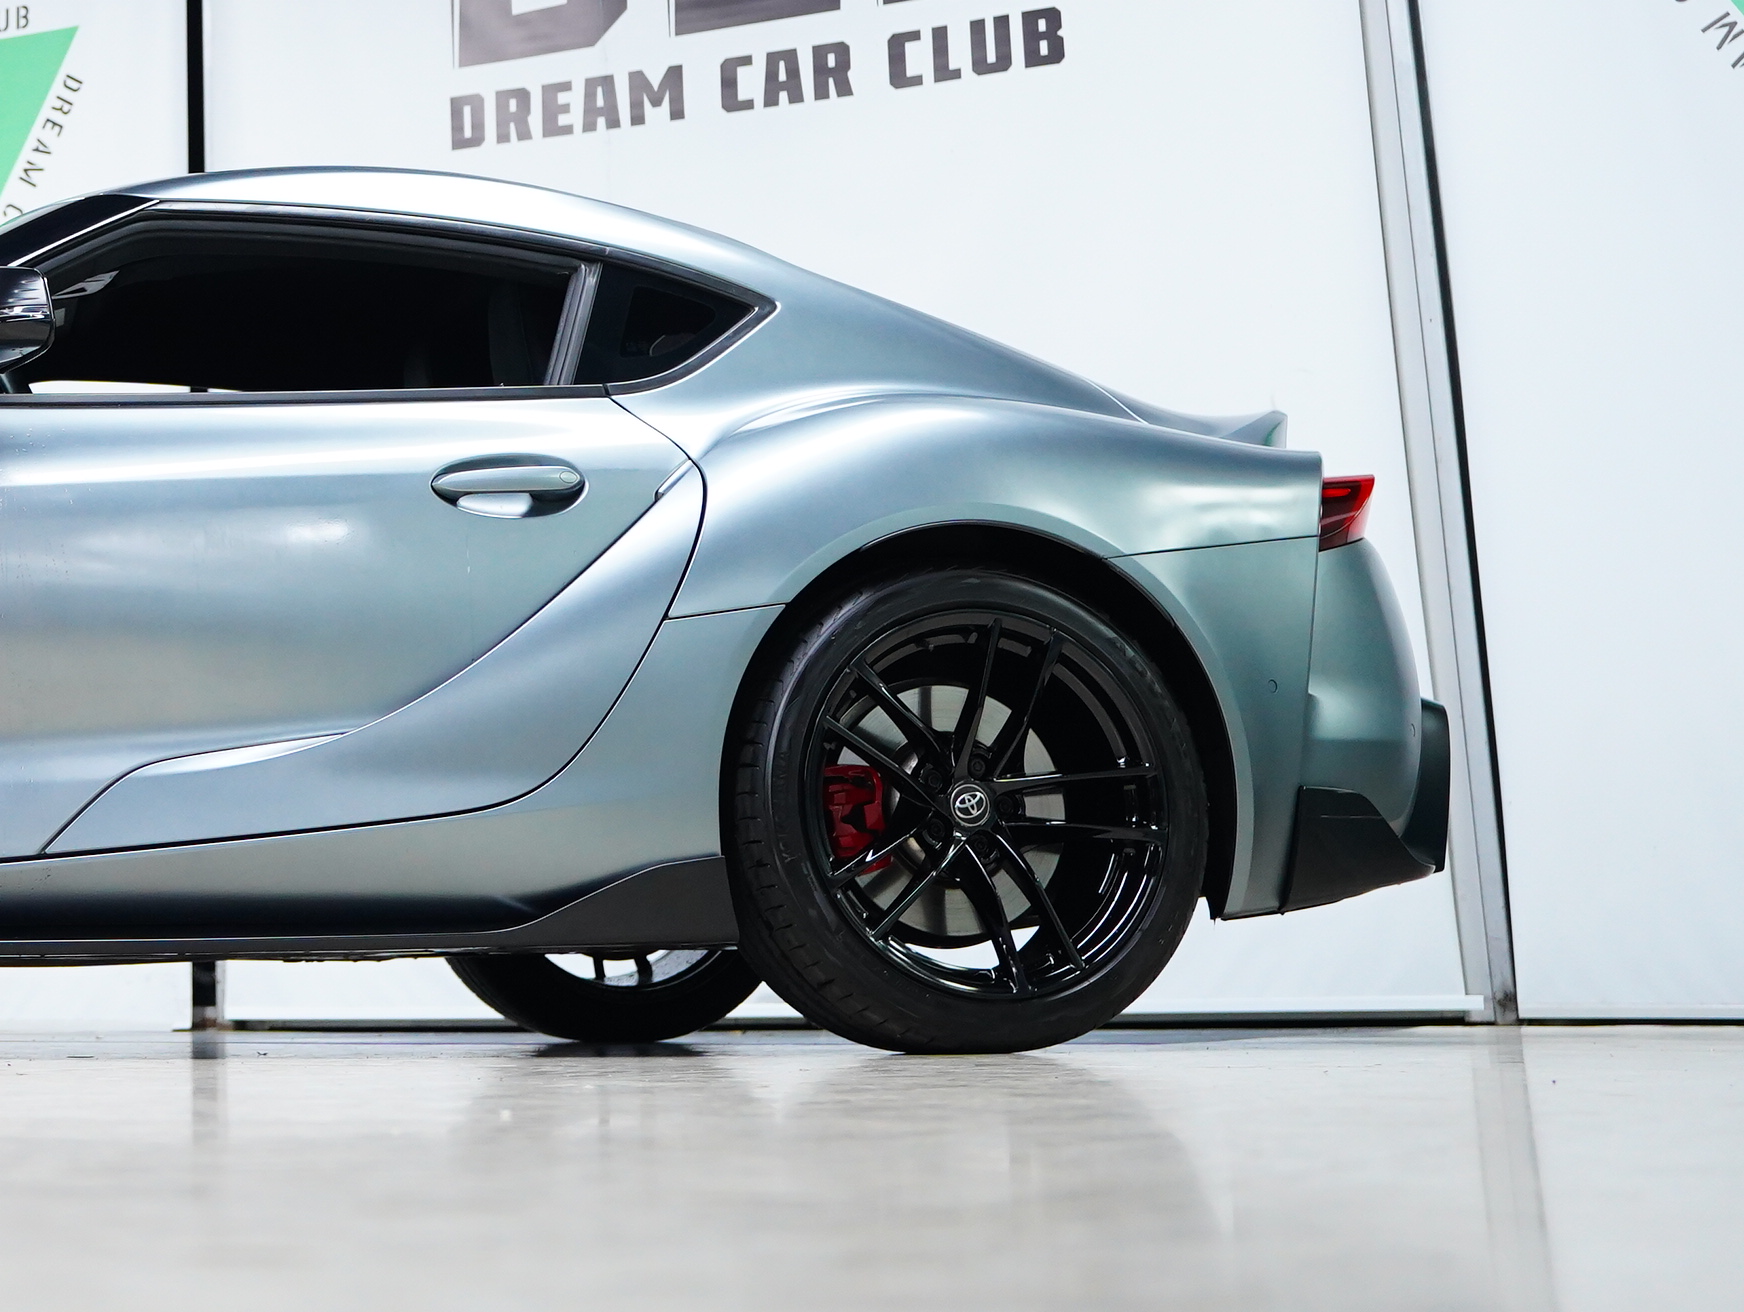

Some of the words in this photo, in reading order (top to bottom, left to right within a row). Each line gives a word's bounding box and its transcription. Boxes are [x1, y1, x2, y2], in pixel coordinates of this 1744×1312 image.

[18, 73, 84, 188] DREAM
[449, 64, 686, 151] DREAM
[719, 40, 855, 114] CAR
[887, 6, 1066, 90] CLUB
